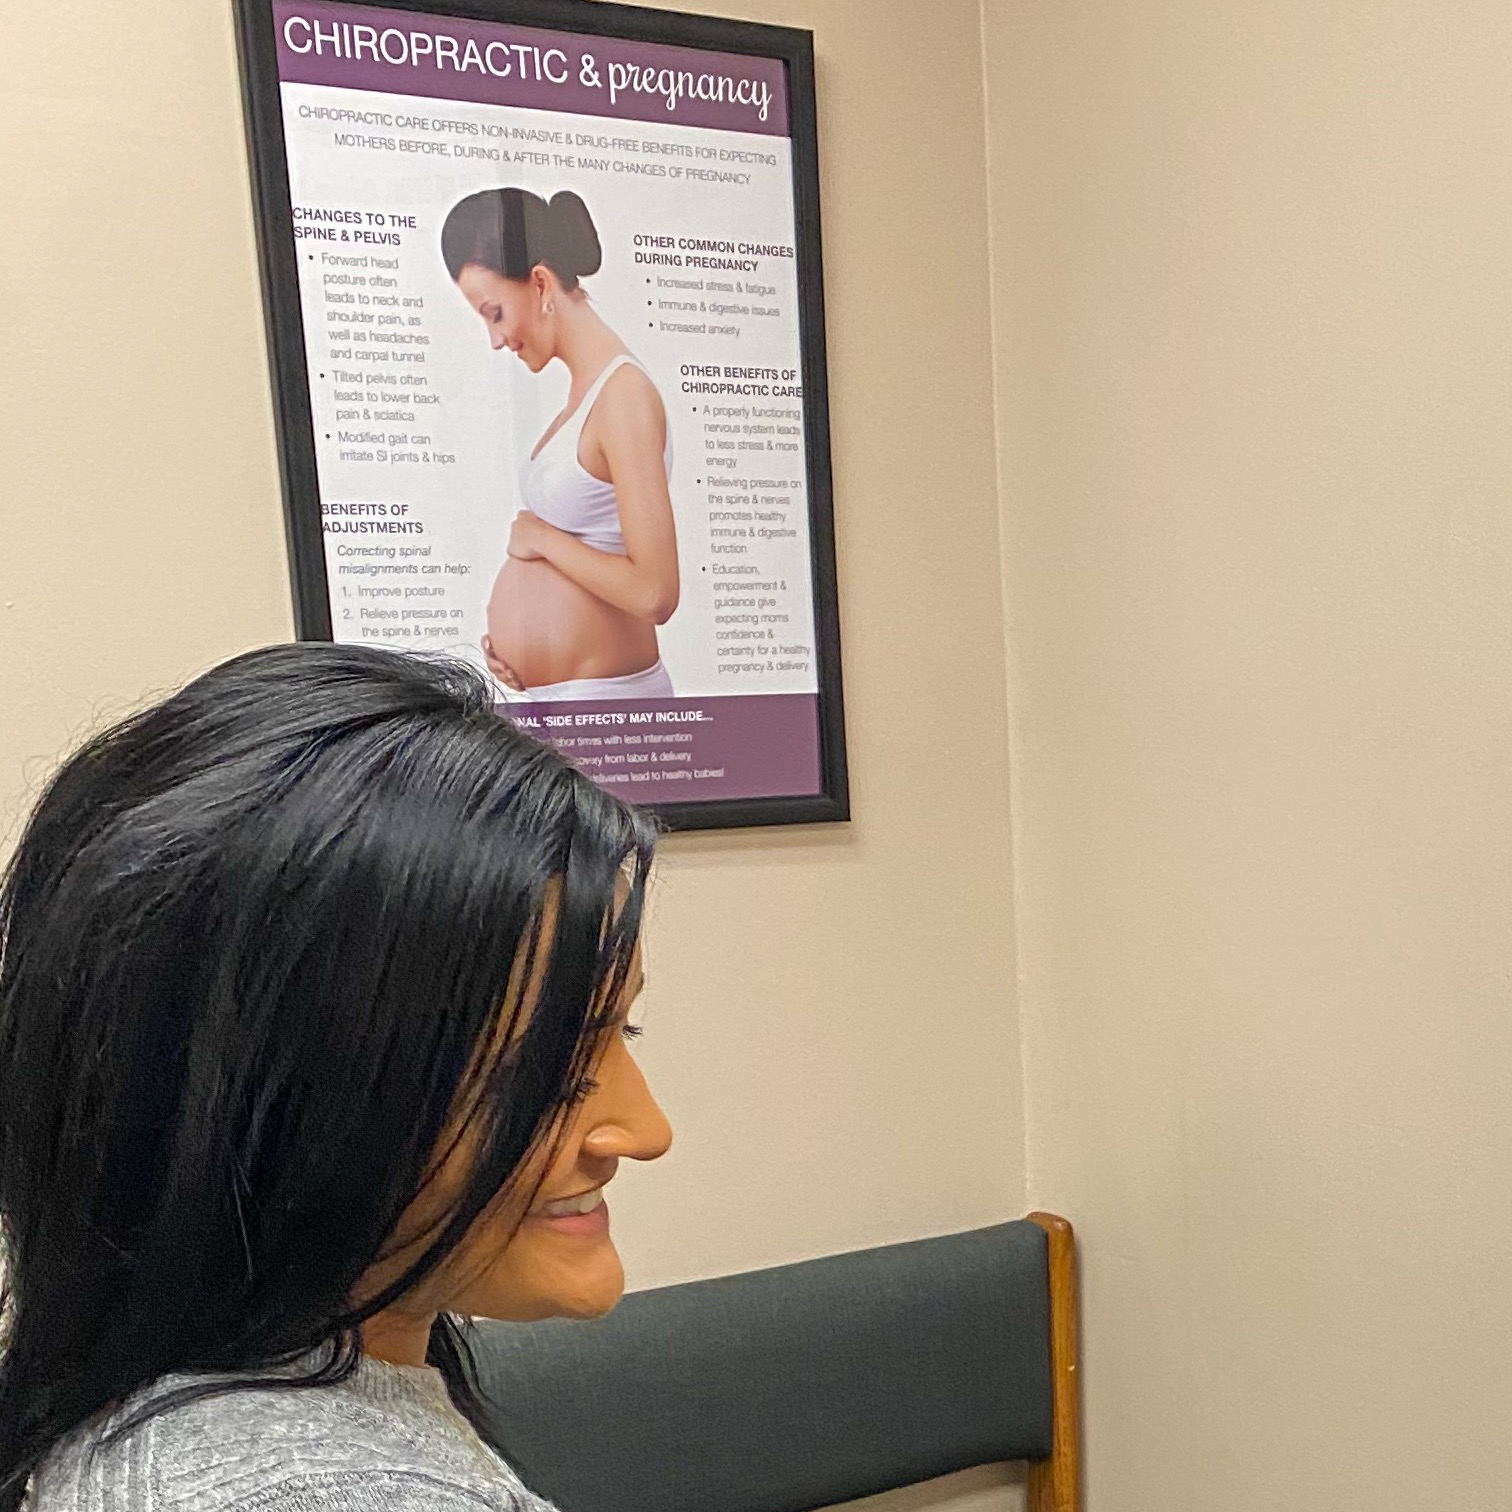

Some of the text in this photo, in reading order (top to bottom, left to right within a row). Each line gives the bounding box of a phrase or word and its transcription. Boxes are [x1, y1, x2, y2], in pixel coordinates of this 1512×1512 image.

[283, 16, 772, 121] CHIROPRACTIC & pregnancy
[298, 104, 777, 166] CHIROPRACTIC CARE OFFERS NON-INVASIVE & DRUG-FREE BENEFITS FOR EXPECTING
[333, 133, 751, 185] MOTHERS BEFORE, DURING & AFTER THE MANY CHANGES OF PREGNANCY
[292, 206, 417, 229] CHANGES TO THE
[293, 225, 401, 246] SPINE & PELVIS
[633, 233, 794, 258] OTHER COMMON CHANGES
[321, 251, 400, 270] Forward head
[634, 250, 759, 273] DURING PREGNANCY
[323, 273, 398, 288] posture often
[656, 275, 704, 291] Increased
[705, 279, 734, 293] stress
[736, 281, 743, 293] &
[324, 290, 424, 308] leads to neck and
[658, 297, 698, 312] Immune
[699, 300, 707, 312] &
[708, 302, 750, 317] digestive
[326, 308, 374, 323] shoulder
[408, 315, 422, 326] as
[659, 319, 706, 335] Increased
[328, 328, 430, 345] well as headaches
[330, 346, 425, 363] and carpal tunnel
[332, 369, 428, 386] Tilted pelvis often
[680, 363, 797, 381] OTHER BENEFITS OF
[334, 389, 441, 405] leads to lower back
[681, 380, 803, 398] CHIROPRACTIC CARE
[336, 408, 415, 422] pain & sciatica
[337, 430, 431, 446] Modified gait can
[339, 449, 456, 465] irritate SI joints & hips
[321, 503, 409, 516] BENEFITS OF
[322, 520, 424, 534] ADJUSTMENTS
[336, 544, 432, 559] Correcting spinal
[338, 561, 472, 577] misalignments can help:
[357, 585, 402, 599] Improve
[404, 585, 446, 599] posture
[359, 607, 399, 620] Relieve
[401, 608, 448, 622] pressure
[449, 608, 464, 619] on
[361, 624, 459, 639] the spine & nerves
[543, 714, 573, 728] 'SIDE
[575, 712, 628, 727] EFFECTS'
[629, 711, 654, 724] MAY
[603, 734, 623, 746] with
